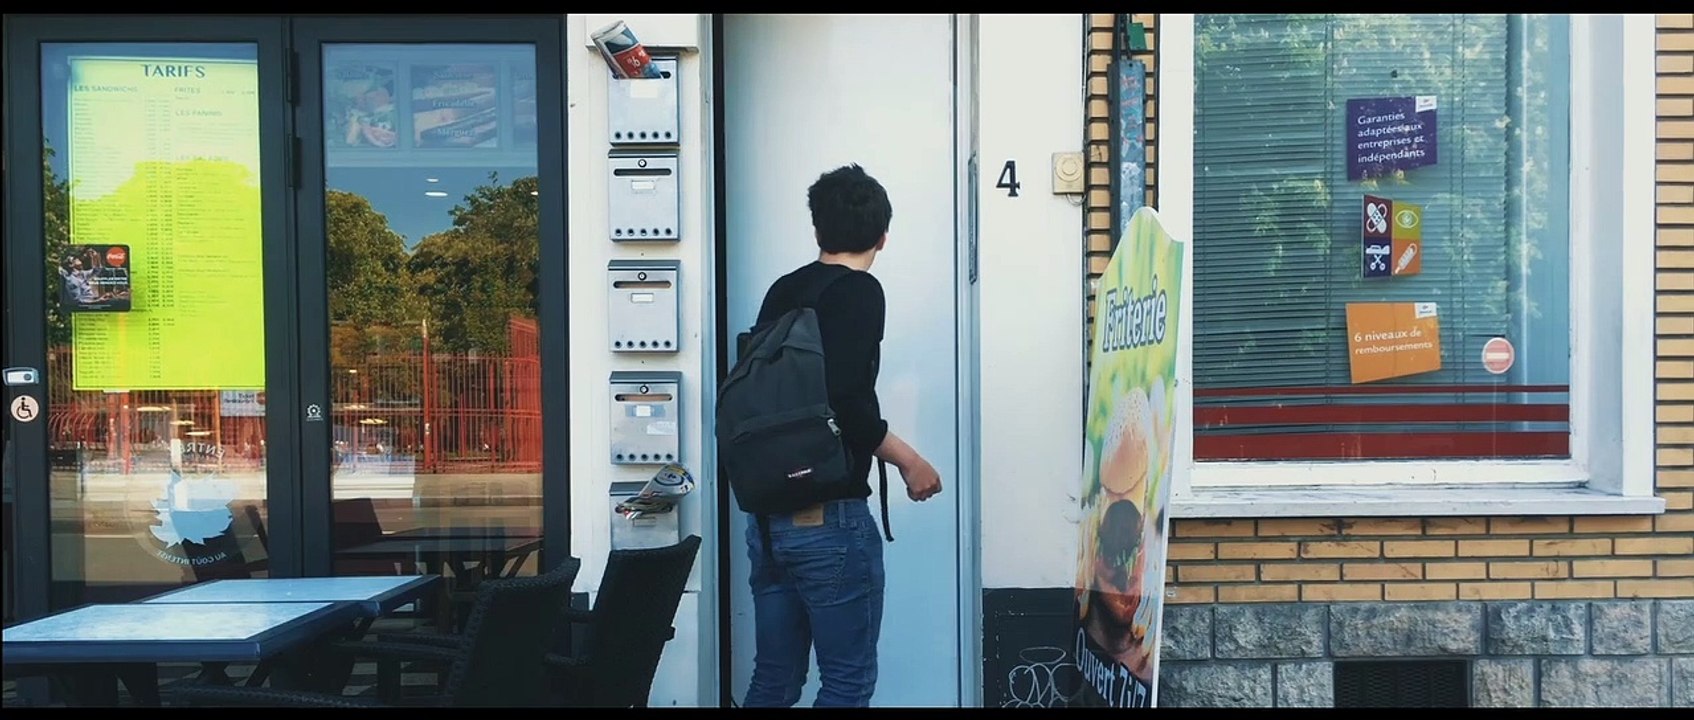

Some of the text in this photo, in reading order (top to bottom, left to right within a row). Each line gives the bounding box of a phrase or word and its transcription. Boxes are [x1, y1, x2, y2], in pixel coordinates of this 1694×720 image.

[142, 64, 206, 78] TARIFS
[1357, 112, 1406, 125] Garanties
[1357, 123, 1423, 138] adaptées aux
[1357, 135, 1425, 150] entreprises et
[1357, 149, 1426, 163] indépendants
[996, 160, 1021, 197] 4
[1102, 273, 1168, 353] Friterie
[1354, 326, 1422, 343] 6 niveaux de
[1355, 341, 1433, 355] remboursements
[1075, 627, 1116, 708] Ouvert
